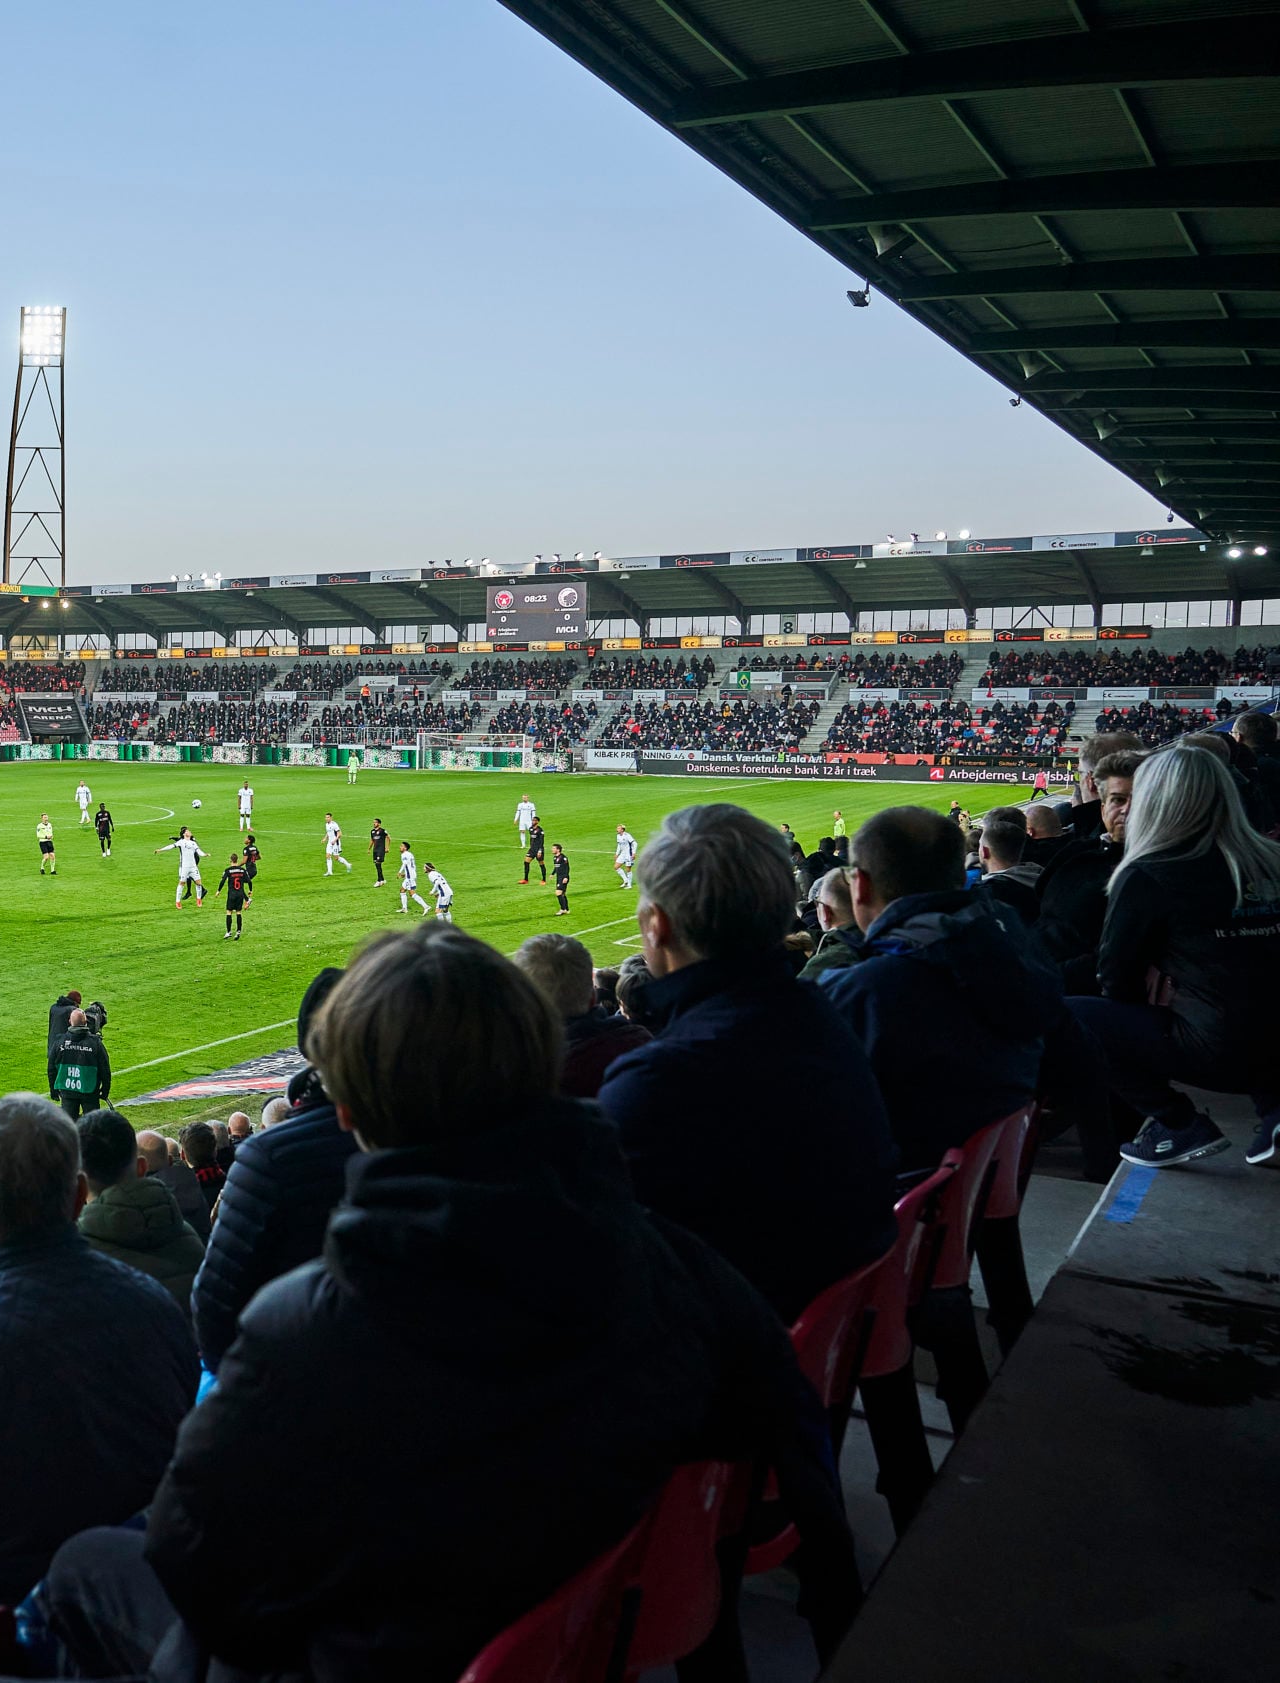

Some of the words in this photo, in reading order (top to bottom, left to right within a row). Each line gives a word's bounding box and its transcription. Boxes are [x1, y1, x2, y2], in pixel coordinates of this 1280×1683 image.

[524, 594, 548, 603] 08:23
[556, 626, 579, 634] MCH
[784, 622, 794, 634] 8
[420, 632, 428, 643] 7
[594, 751, 619, 759] KIBÆK
[703, 754, 733, 762] Dansk
[687, 764, 740, 773] Danskernes
[742, 764, 792, 774] foretrukne
[795, 765, 819, 775] bank
[823, 766, 833, 775] 12
[834, 766, 845, 775] år
[847, 766, 851, 775] i
[853, 767, 877, 776] træk
[949, 770, 1017, 782] Arbejdernes
[234, 878, 241, 890] 6
[68, 1067, 81, 1078] HB
[66, 1079, 82, 1090] 060
